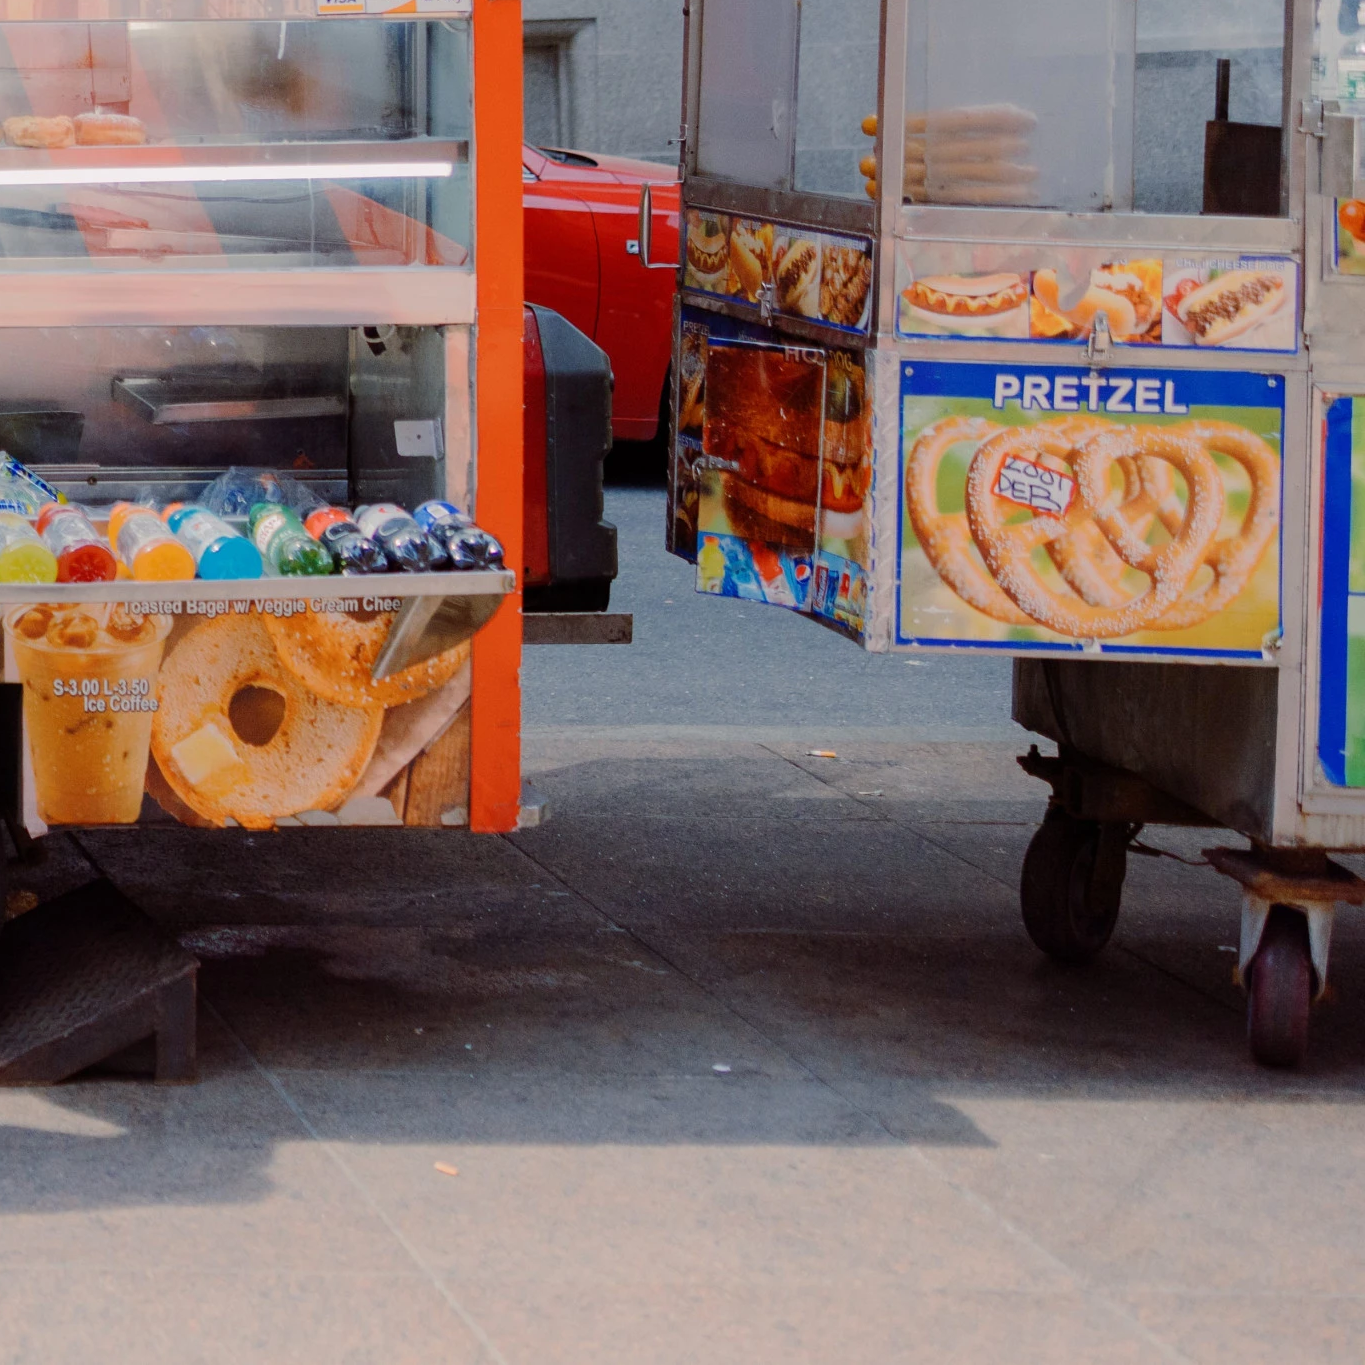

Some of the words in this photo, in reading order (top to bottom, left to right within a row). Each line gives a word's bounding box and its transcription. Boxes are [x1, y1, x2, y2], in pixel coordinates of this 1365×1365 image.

[993, 373, 1190, 415] PRETZEL
[185, 598, 229, 619] Bagel
[233, 598, 250, 614] w/
[254, 598, 307, 618] Veggie
[309, 597, 359, 613] Cream
[52, 678, 100, 697] S-3.00
[103, 678, 150, 696] L-3.50
[83, 694, 106, 712] Ice
[109, 694, 159, 712] Coffee
